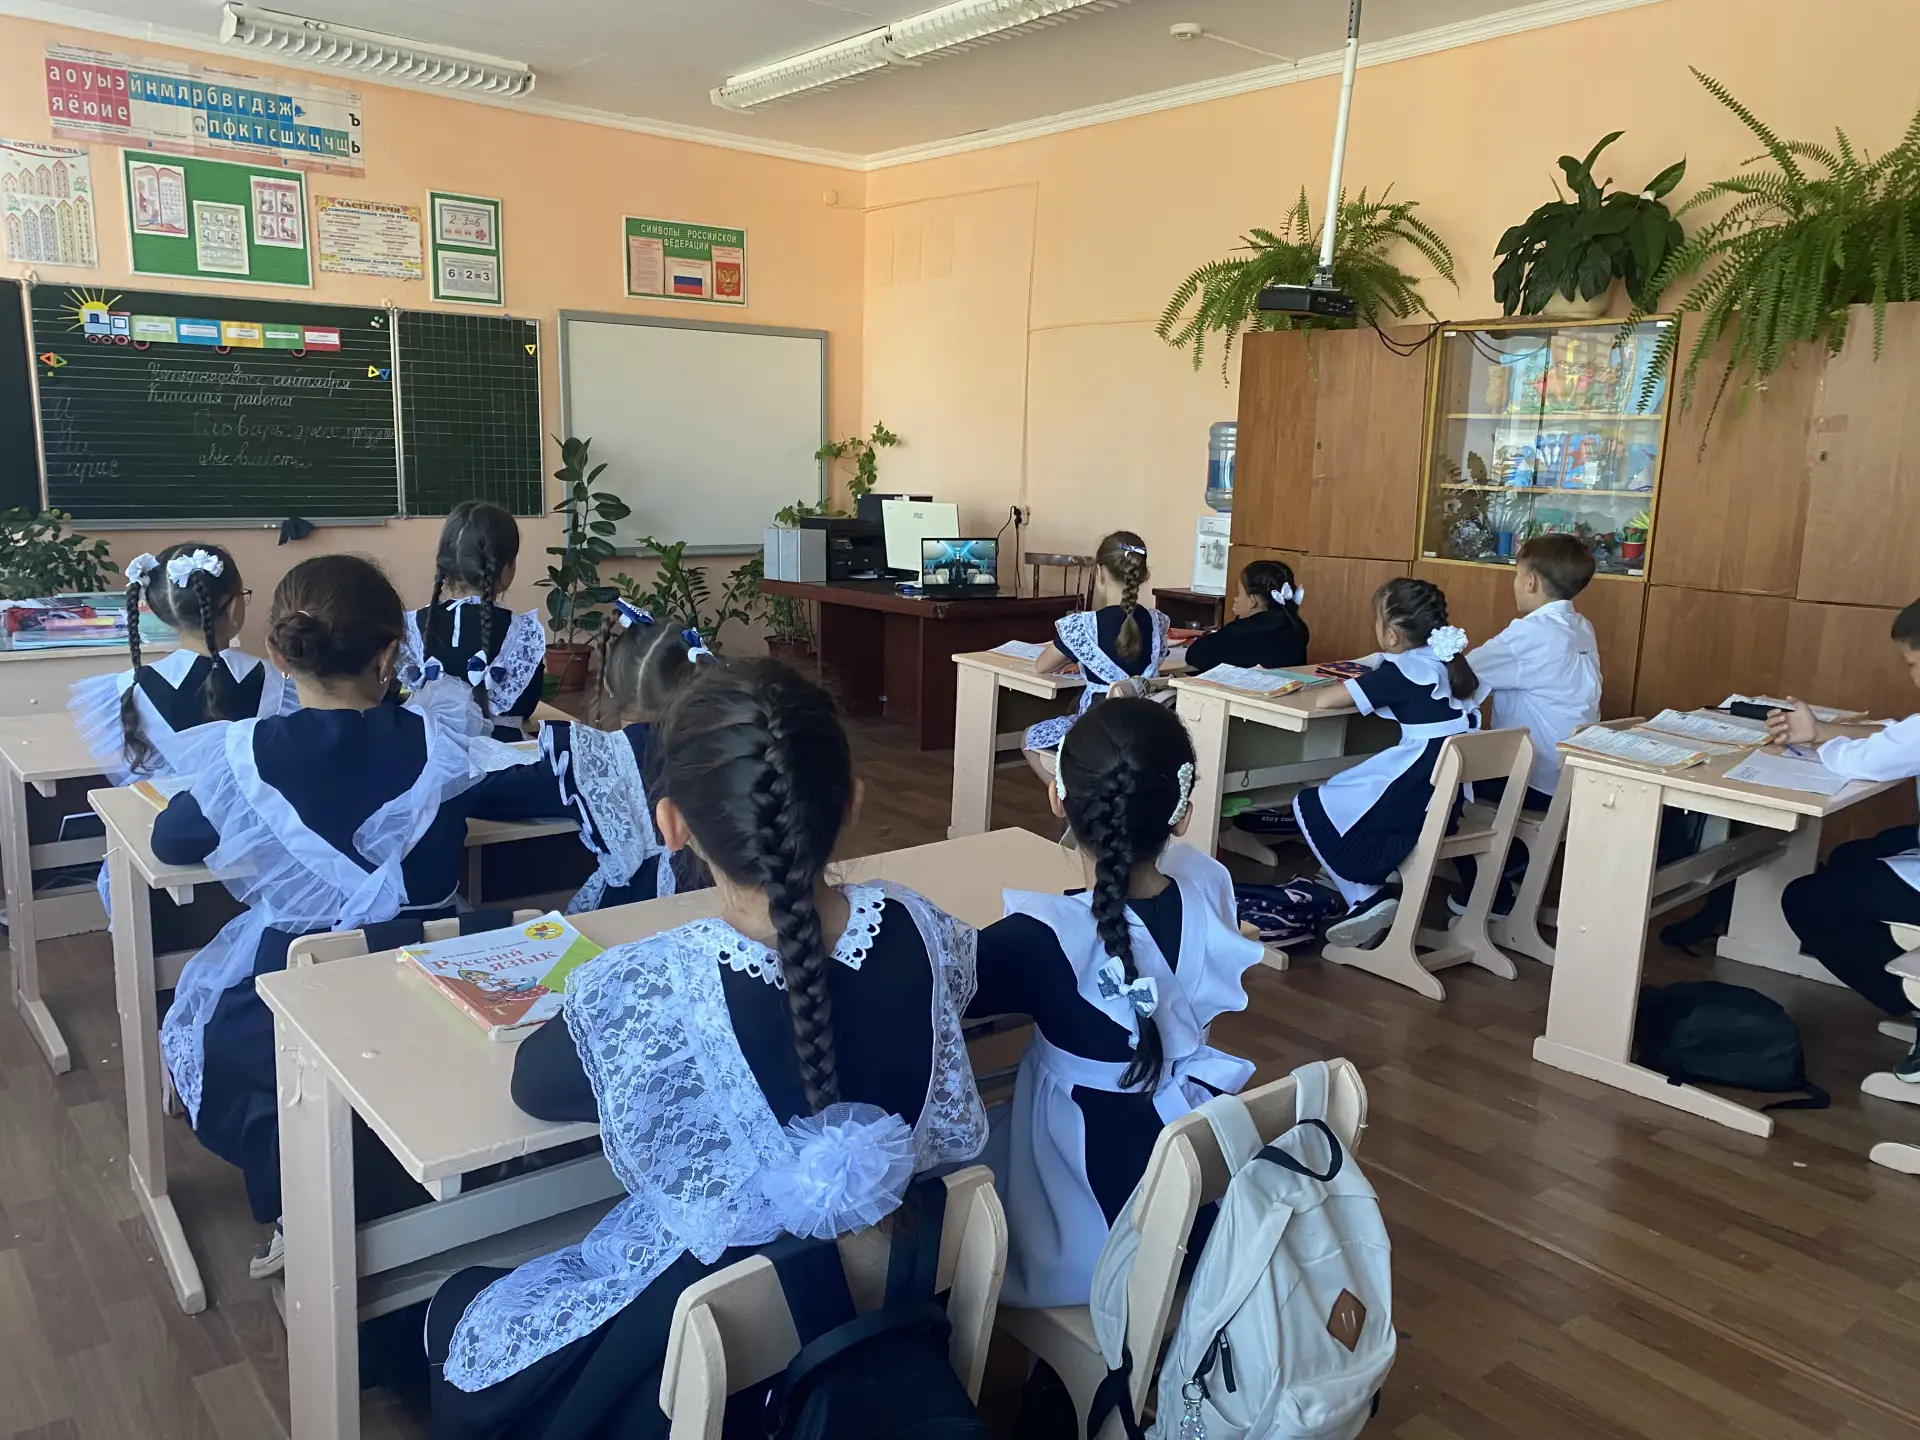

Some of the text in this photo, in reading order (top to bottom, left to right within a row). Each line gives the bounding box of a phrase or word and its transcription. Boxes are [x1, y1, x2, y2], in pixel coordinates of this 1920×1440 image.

[13, 141, 78, 155] СОСТАВ ЧИСЛА
[336, 200, 401, 214] ЧАСТИ РЕЧИ
[640, 224, 681, 237] СИМВОЛЫ
[663, 238, 709, 251] ФЕДЕРАЦИИ
[147, 382, 293, 411] Классная работа
